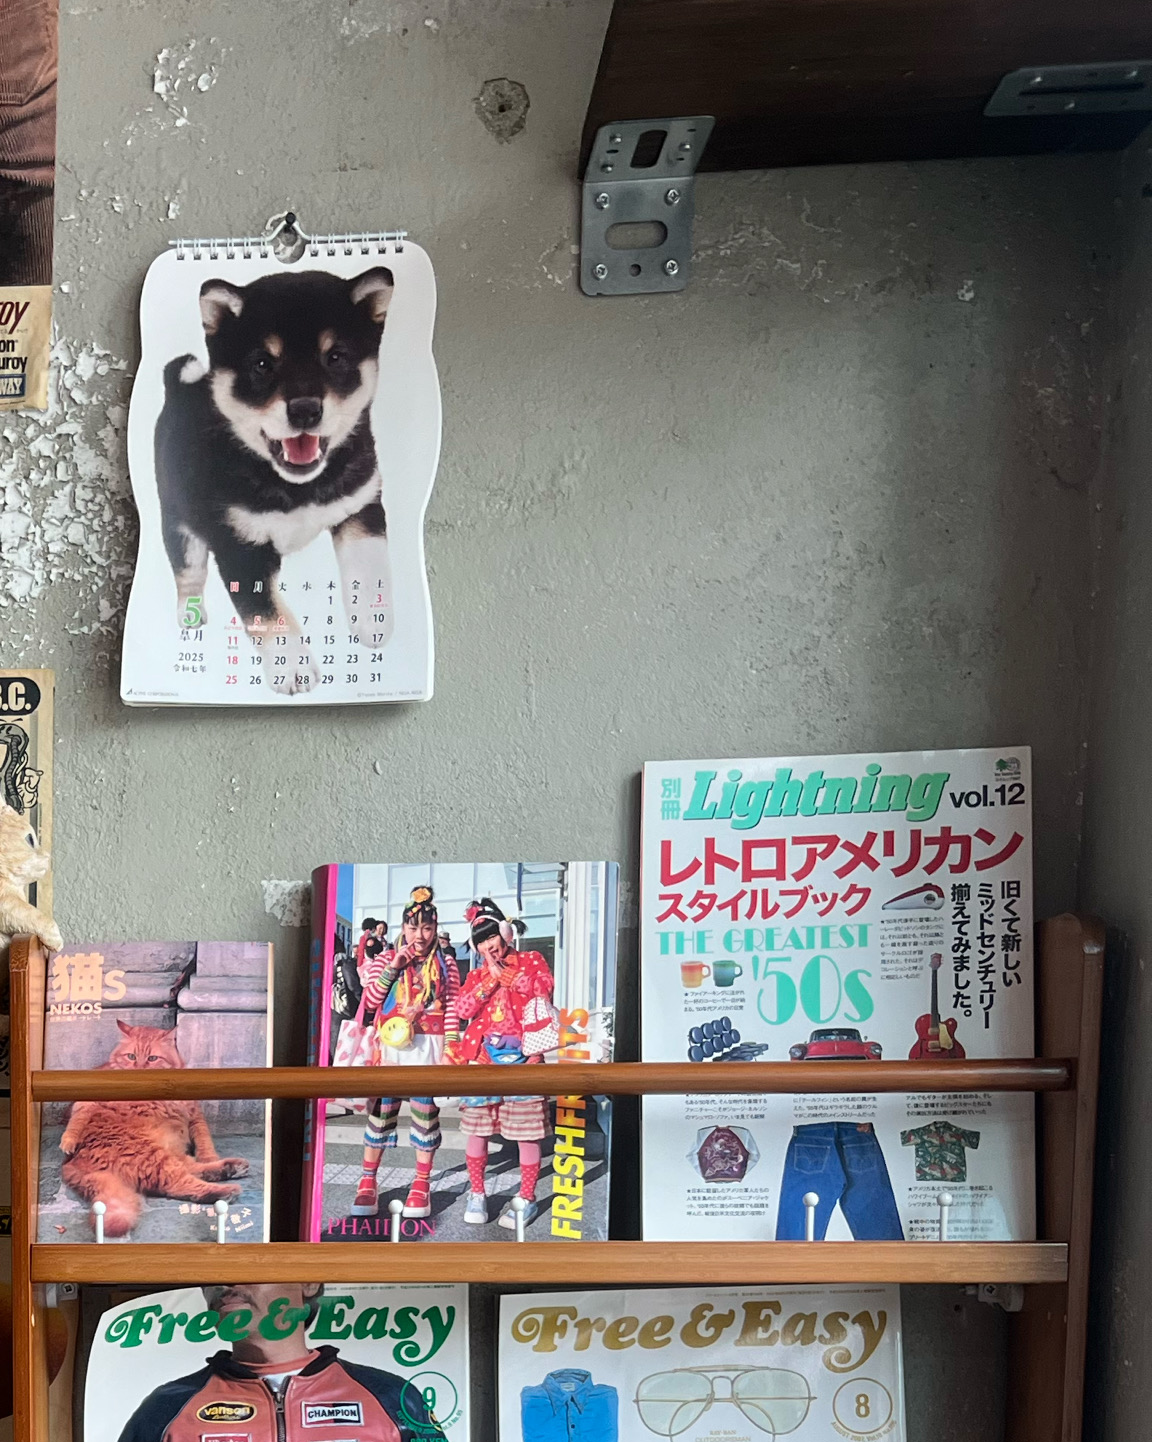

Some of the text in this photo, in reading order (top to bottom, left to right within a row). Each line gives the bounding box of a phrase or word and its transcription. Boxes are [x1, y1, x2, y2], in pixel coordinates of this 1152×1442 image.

[183, 596, 203, 627] 5
[178, 652, 204, 662] 2025
[660, 777, 681, 821] 別冊
[682, 763, 1026, 831] Lightning vol.12
[659, 825, 1025, 888] レトロアメリカン
[655, 882, 873, 924] スタイルブック
[655, 929, 715, 956] THE
[723, 922, 874, 954] GREATEST
[950, 882, 973, 1019] 揃えてみました。
[1000, 880, 1023, 988] 旧くて新しい
[976, 881, 998, 1030] ミッドセンチュリー
[49, 1002, 103, 1015] NEKOS
[204, 1405, 251, 1415] vanson
[307, 1408, 358, 1419] CHAMPION
[422, 1386, 438, 1411] 9
[854, 1393, 871, 1419] 8
